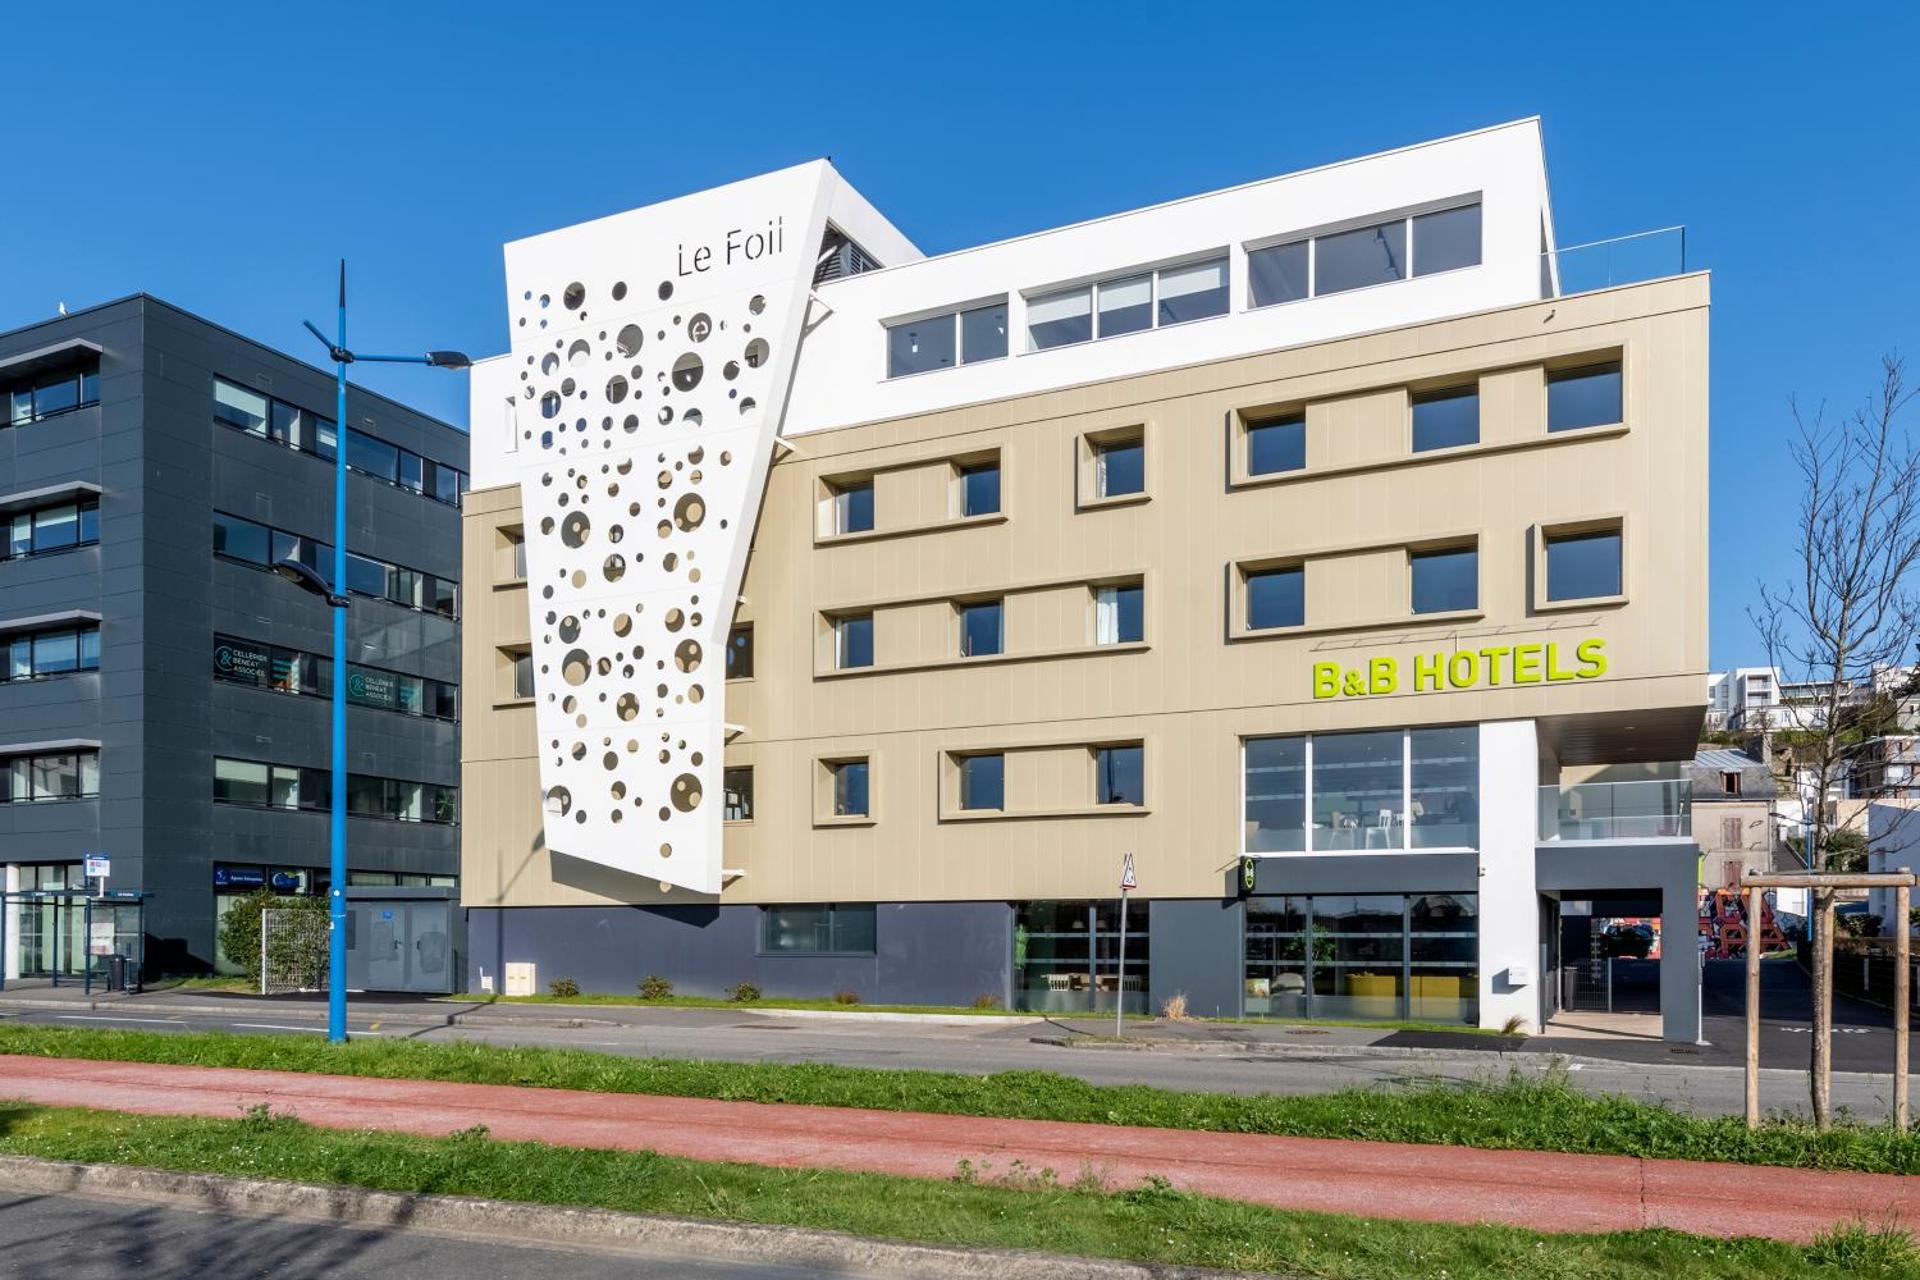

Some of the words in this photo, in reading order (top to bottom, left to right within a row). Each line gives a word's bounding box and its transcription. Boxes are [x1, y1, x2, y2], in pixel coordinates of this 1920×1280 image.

[678, 243, 711, 277] Le
[726, 215, 783, 266] Foil
[1313, 657, 1398, 699] B&B
[1414, 638, 1607, 692] HOTELS
